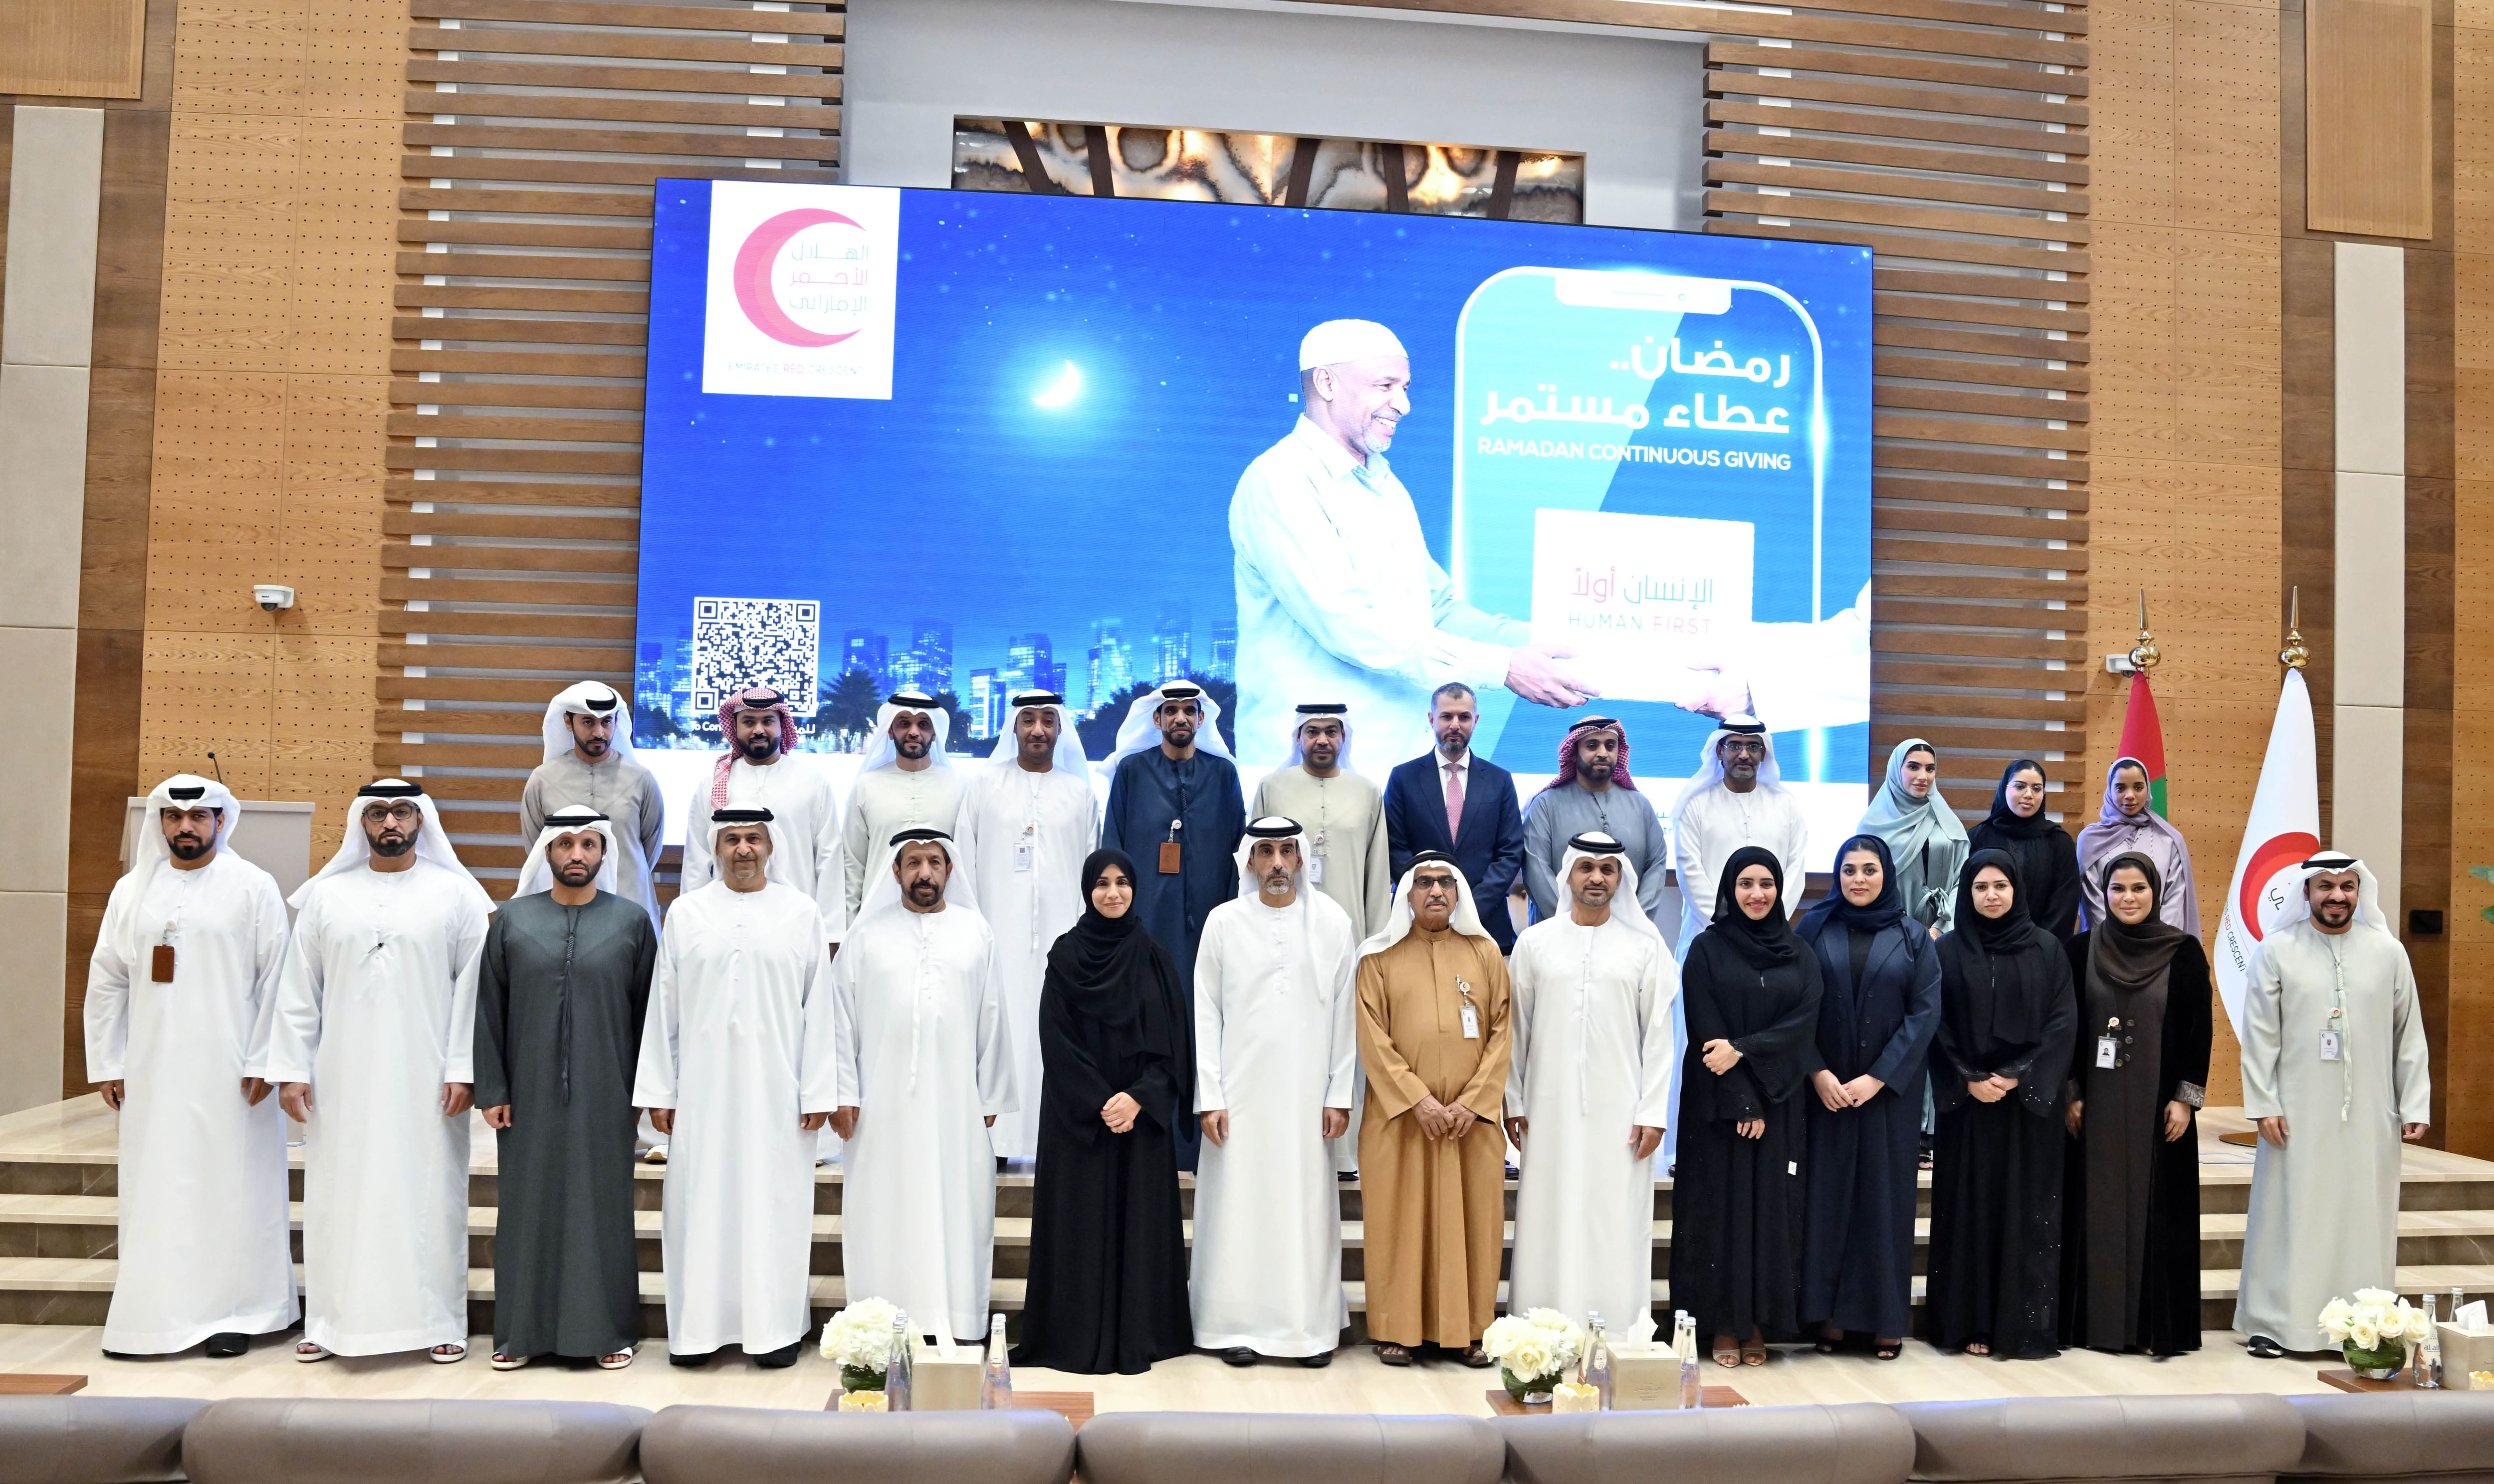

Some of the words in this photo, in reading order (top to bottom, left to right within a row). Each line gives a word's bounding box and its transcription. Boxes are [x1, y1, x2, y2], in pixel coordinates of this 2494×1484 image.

[791, 242, 869, 261] الهلال
[790, 267, 868, 287] الأحمر
[789, 294, 867, 316] الإماراتي
[728, 362, 780, 373] EMIRATES
[783, 364, 804, 374] RED
[808, 365, 863, 375] CRESCENT
[1610, 336, 1790, 388] رمضان..
[1480, 384, 1650, 429] مستمر
[1663, 393, 1790, 434] عطاء
[1478, 437, 1584, 461] RAMADAN
[1587, 444, 1721, 468] CONTINUOUS
[1724, 450, 1791, 470] GIVING
[1624, 575, 1713, 610] الإنسان
[1569, 612, 1642, 631] HUMAN
[1653, 616, 1711, 634] FIRST
[690, 721, 701, 731] To
